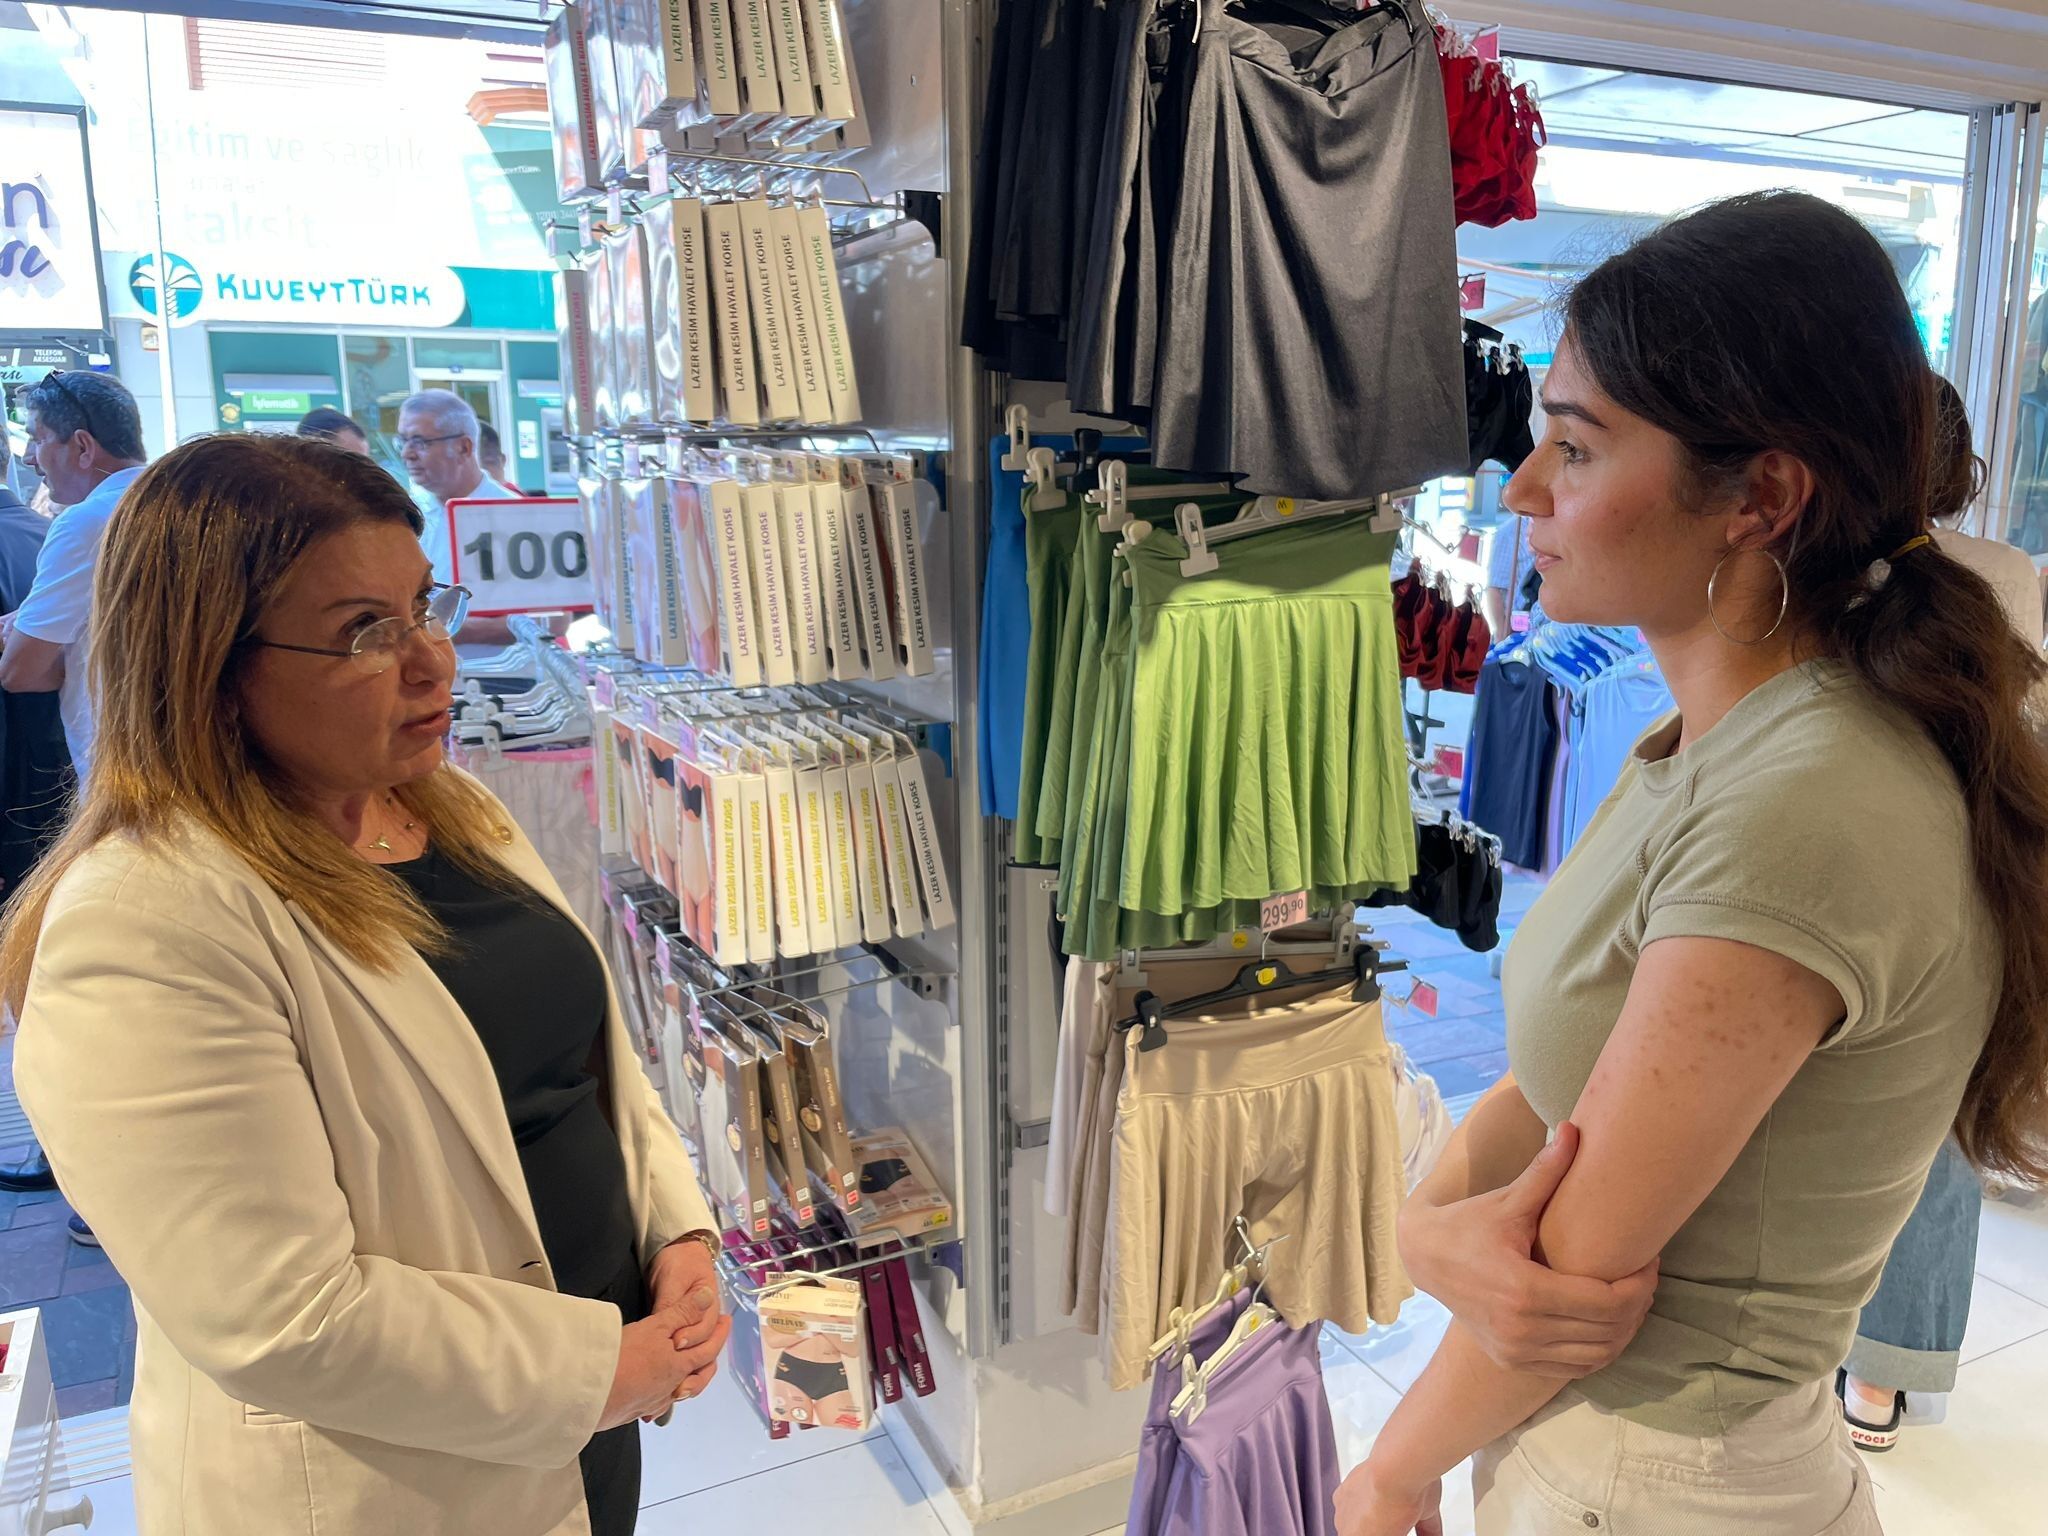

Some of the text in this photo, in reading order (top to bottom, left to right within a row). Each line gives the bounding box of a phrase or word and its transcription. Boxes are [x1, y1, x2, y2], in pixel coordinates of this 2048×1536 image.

[672, 24, 684, 62] LAZER
[709, 2, 728, 79] LAZER KESİM
[747, 1, 768, 78] LAZER KESİM
[781, 6, 801, 82] LAZER KESİM
[820, 10, 835, 46] KESİM
[826, 49, 841, 86] LAZER
[683, 227, 700, 389] LAZER KESİM HAYALET KORSE
[721, 231, 745, 391] LAZER KESİM HAYALET KORSE
[753, 228, 786, 386] LAZER KESİM HAYALET KORSE
[782, 235, 816, 391] LAZER KESİM HAYALET KORSE
[812, 236, 848, 392] LAZER KESİM HAYALET KORSE
[463, 531, 588, 581] 100
[664, 536, 673, 577] HAYALET
[723, 508, 749, 656] LAZER KESİM HAYALET KORSE
[759, 512, 783, 657] LAZER KESİM HAYALET KORSE
[794, 512, 817, 655] LAZER KESİM HAYALET KORSE
[827, 509, 851, 651] LAZER KESİM HAYALET KORSE
[856, 513, 884, 652] LAZER KESİM HAYALET KORSE
[903, 508, 926, 648] LAZER KESİM HAYALET KORSE
[668, 610, 678, 639] LAZER
[907, 780, 942, 903] LAZER KESİM HAYALET KORSE
[882, 1373, 894, 1397] FORM
[913, 1362, 927, 1389] FORM
[1851, 1430, 1885, 1444] crocs
